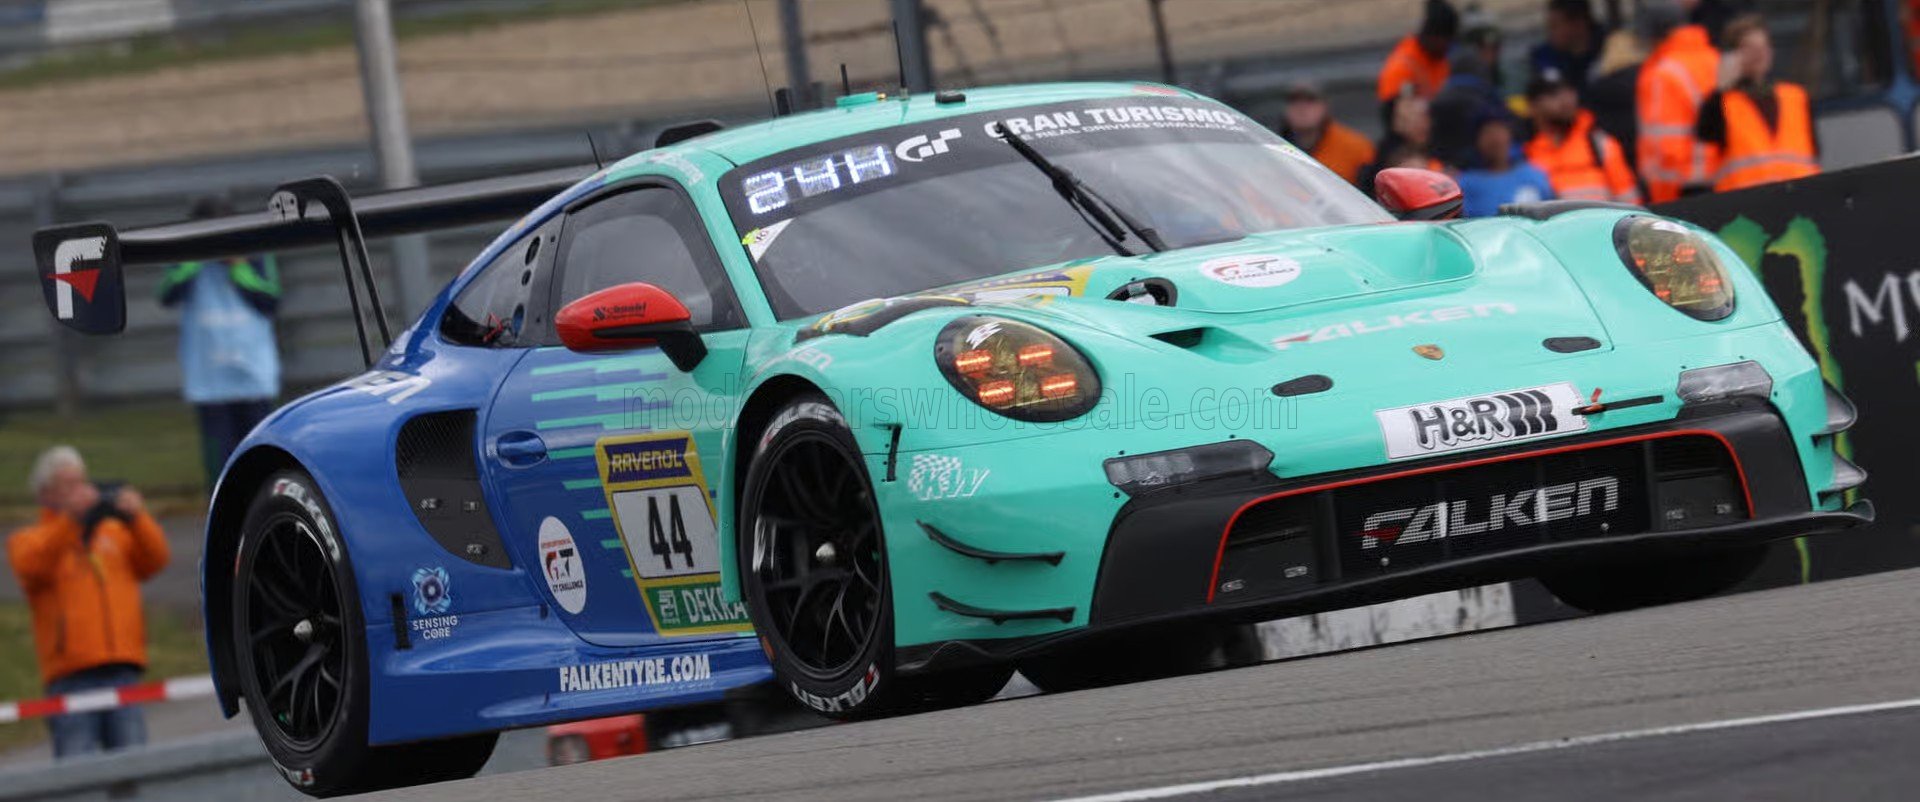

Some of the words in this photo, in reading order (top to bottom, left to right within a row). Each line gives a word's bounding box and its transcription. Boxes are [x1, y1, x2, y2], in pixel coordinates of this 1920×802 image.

[984, 111, 1081, 138] GRAN
[1084, 106, 1237, 125] TURISMO
[744, 145, 891, 215] 24H
[1267, 302, 1518, 351] FALKEN
[1843, 270, 1920, 342] M
[1410, 396, 1524, 450] H&R
[612, 450, 682, 473] RAVENOL
[647, 494, 694, 570] 44
[1358, 476, 1619, 549] FALKEN
[412, 615, 458, 631] SENSING
[681, 587, 749, 624] DEKRA
[423, 627, 451, 640] CORE
[560, 654, 710, 692] FALKENTYRE.COM
